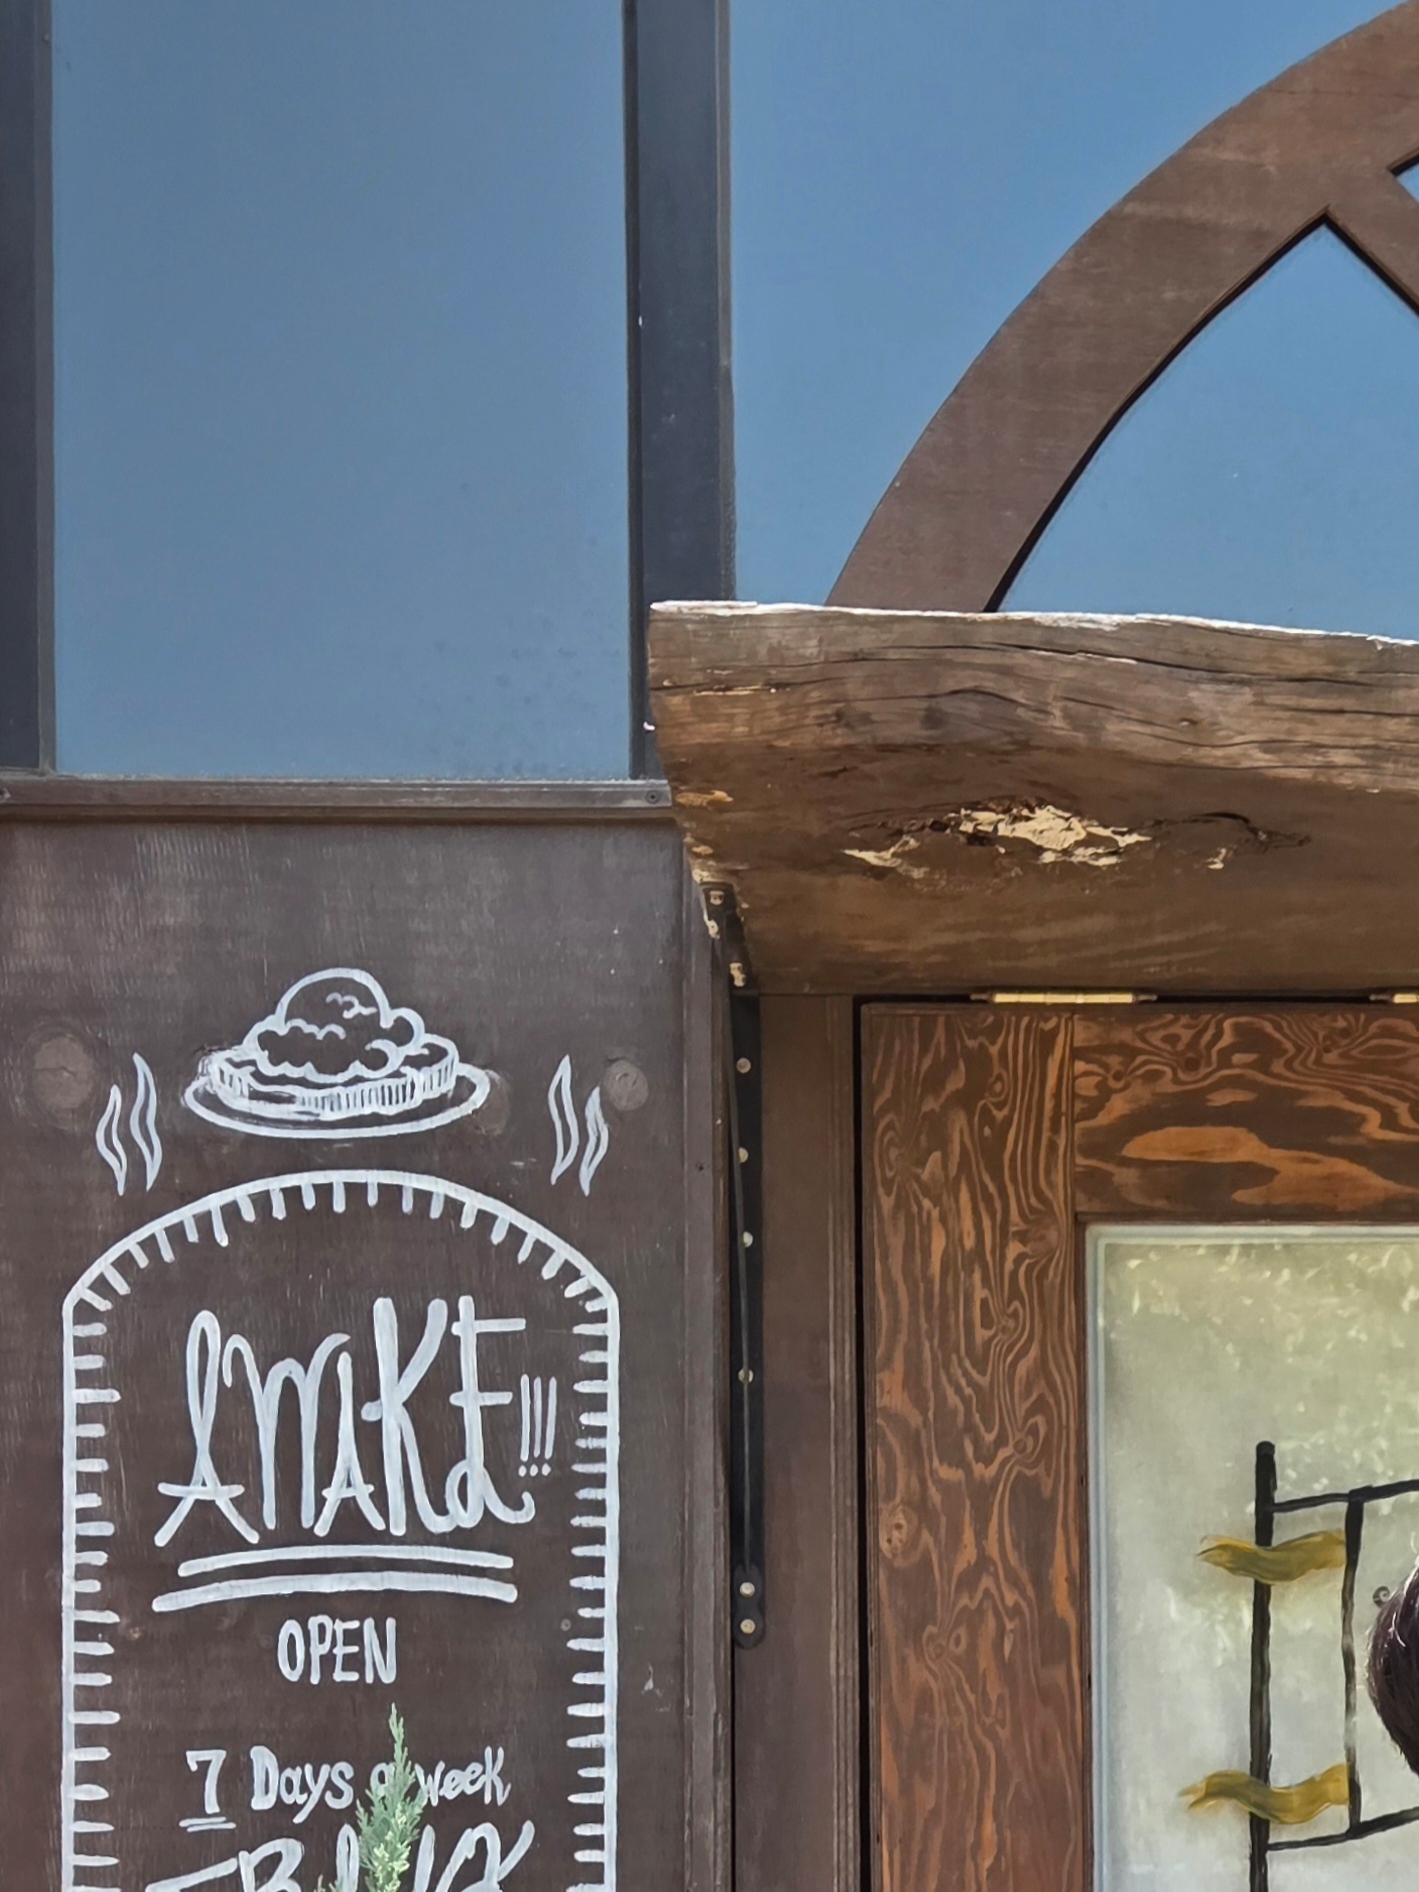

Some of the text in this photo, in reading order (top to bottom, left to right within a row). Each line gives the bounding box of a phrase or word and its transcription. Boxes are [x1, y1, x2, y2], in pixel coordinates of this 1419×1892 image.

[277, 1614, 397, 1685] OPEN
[185, 1749, 227, 1815] 7
[249, 1745, 355, 1824] Days
[414, 1745, 512, 1807] week
